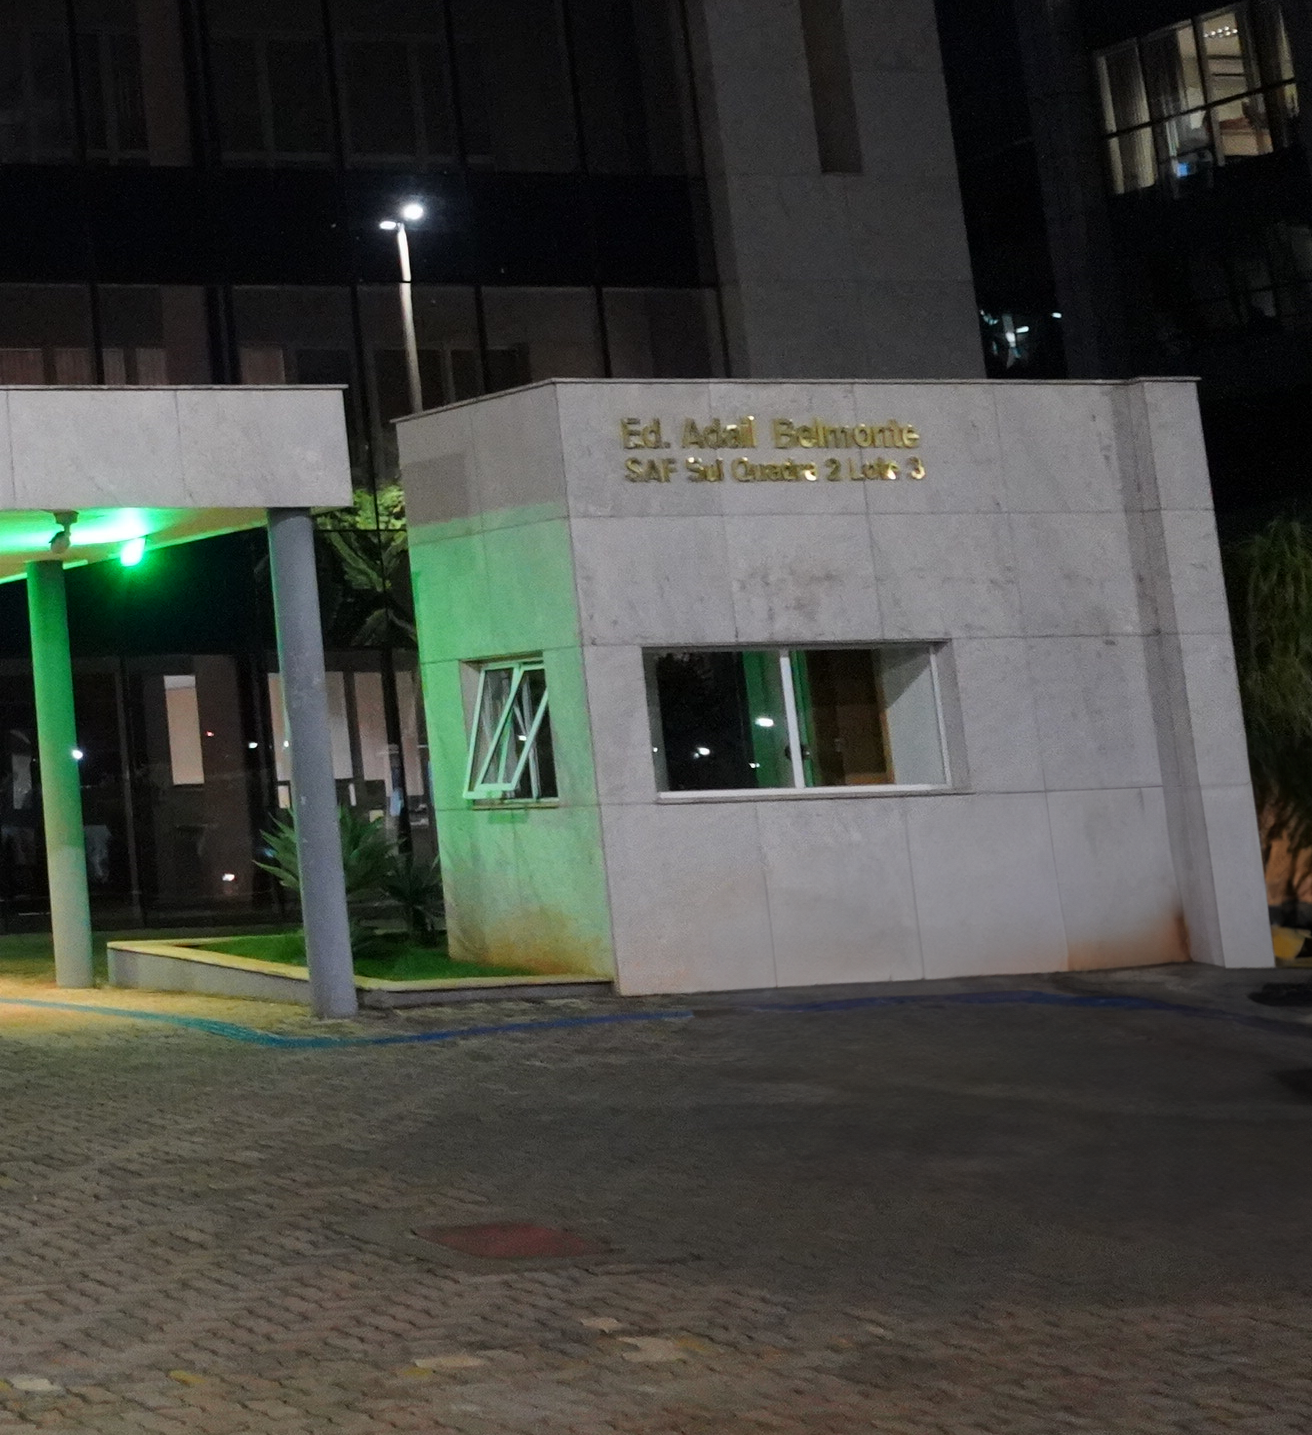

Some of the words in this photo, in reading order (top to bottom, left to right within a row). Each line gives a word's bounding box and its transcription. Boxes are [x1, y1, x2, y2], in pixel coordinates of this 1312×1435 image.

[621, 417, 671, 449] Ed.
[772, 416, 920, 449] Belmonte
[624, 457, 677, 483] SAF
[685, 456, 724, 483] Sul
[730, 456, 818, 483] Quadra
[824, 457, 842, 482] 2
[847, 456, 900, 481] Lote
[906, 456, 926, 480] 3
